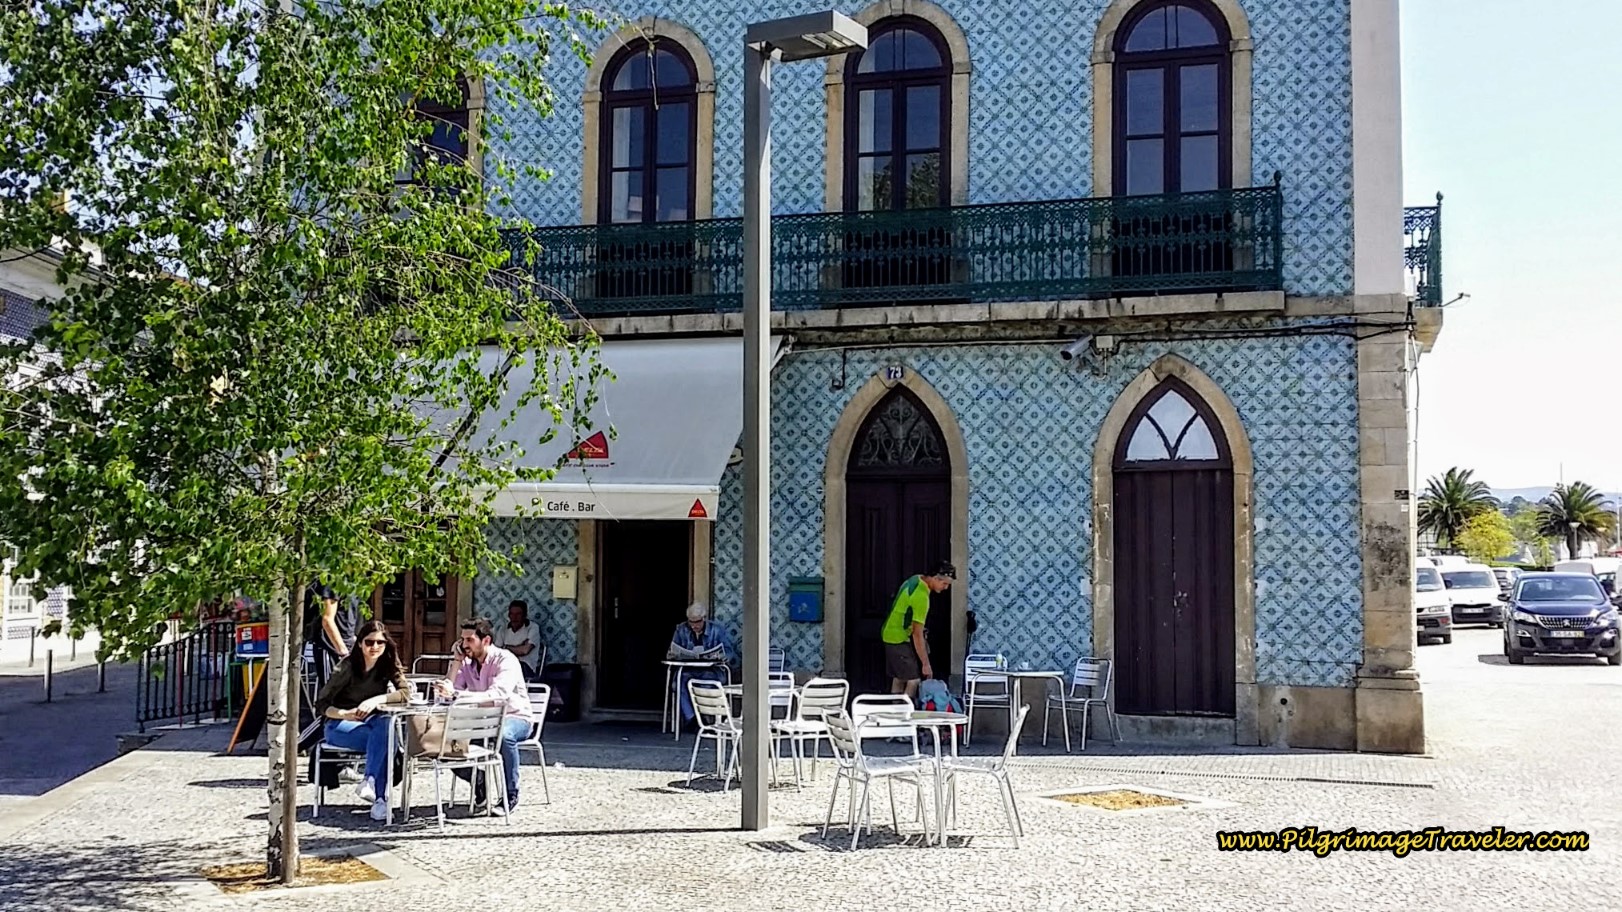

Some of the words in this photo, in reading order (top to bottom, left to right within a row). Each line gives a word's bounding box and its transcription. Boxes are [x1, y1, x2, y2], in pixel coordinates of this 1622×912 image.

[889, 366, 902, 379] 73
[547, 501, 570, 512] Café
[578, 502, 596, 512] Bar
